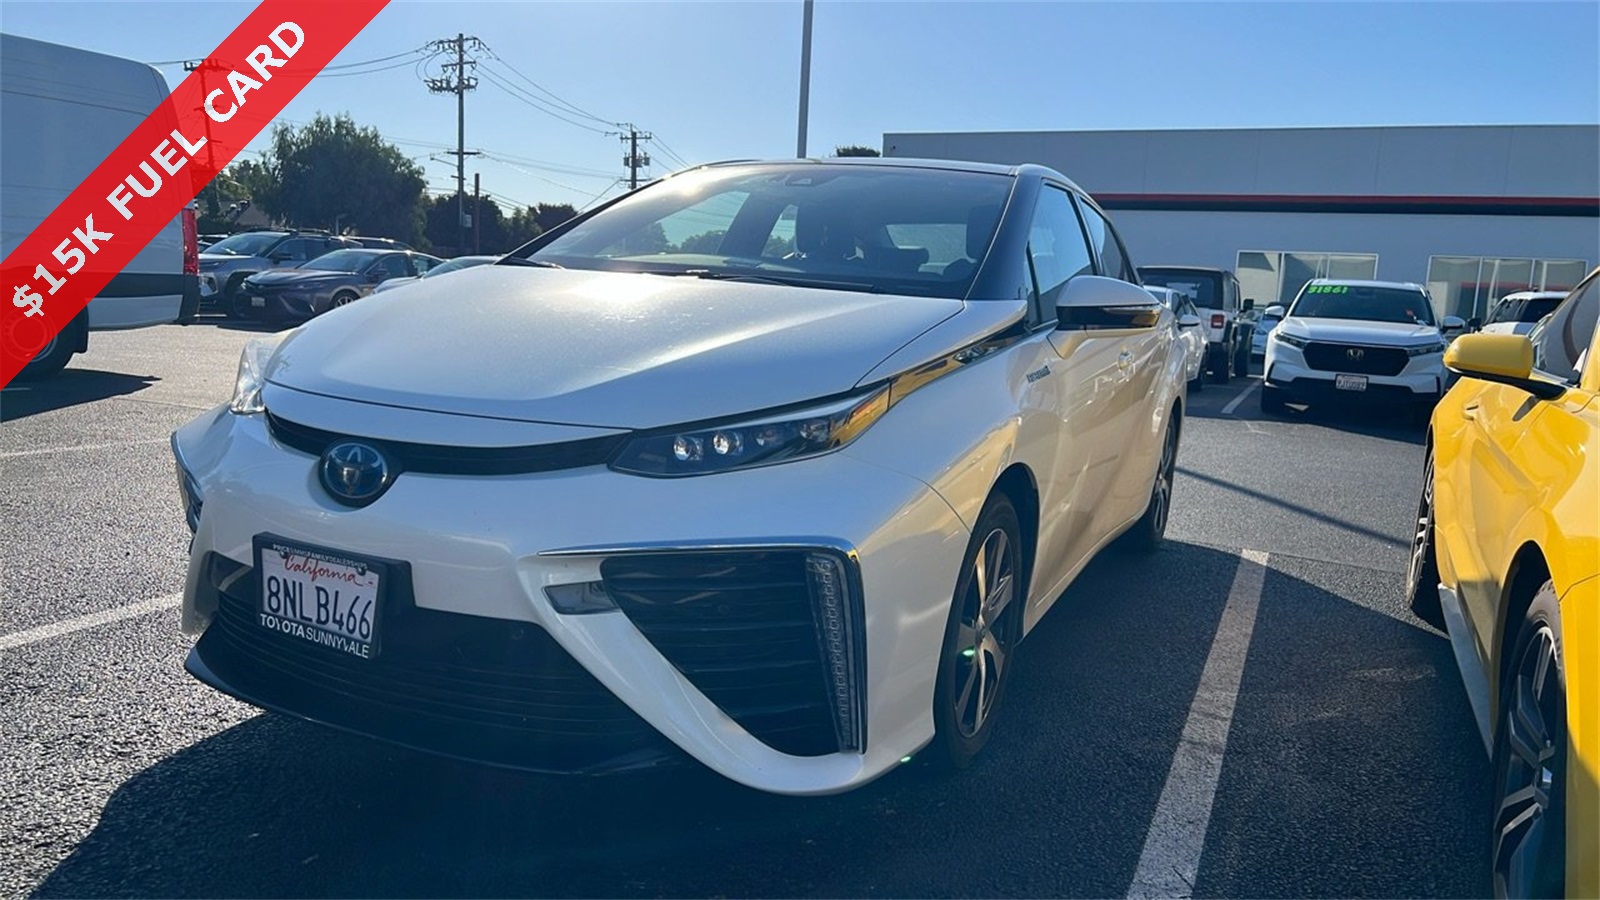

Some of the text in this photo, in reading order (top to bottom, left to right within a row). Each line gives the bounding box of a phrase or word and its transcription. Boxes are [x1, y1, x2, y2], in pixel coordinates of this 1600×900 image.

[284, 553, 364, 586] California
[267, 575, 372, 640] 8NLB466
[260, 613, 370, 659] TOYOTA SUNNYVALE
